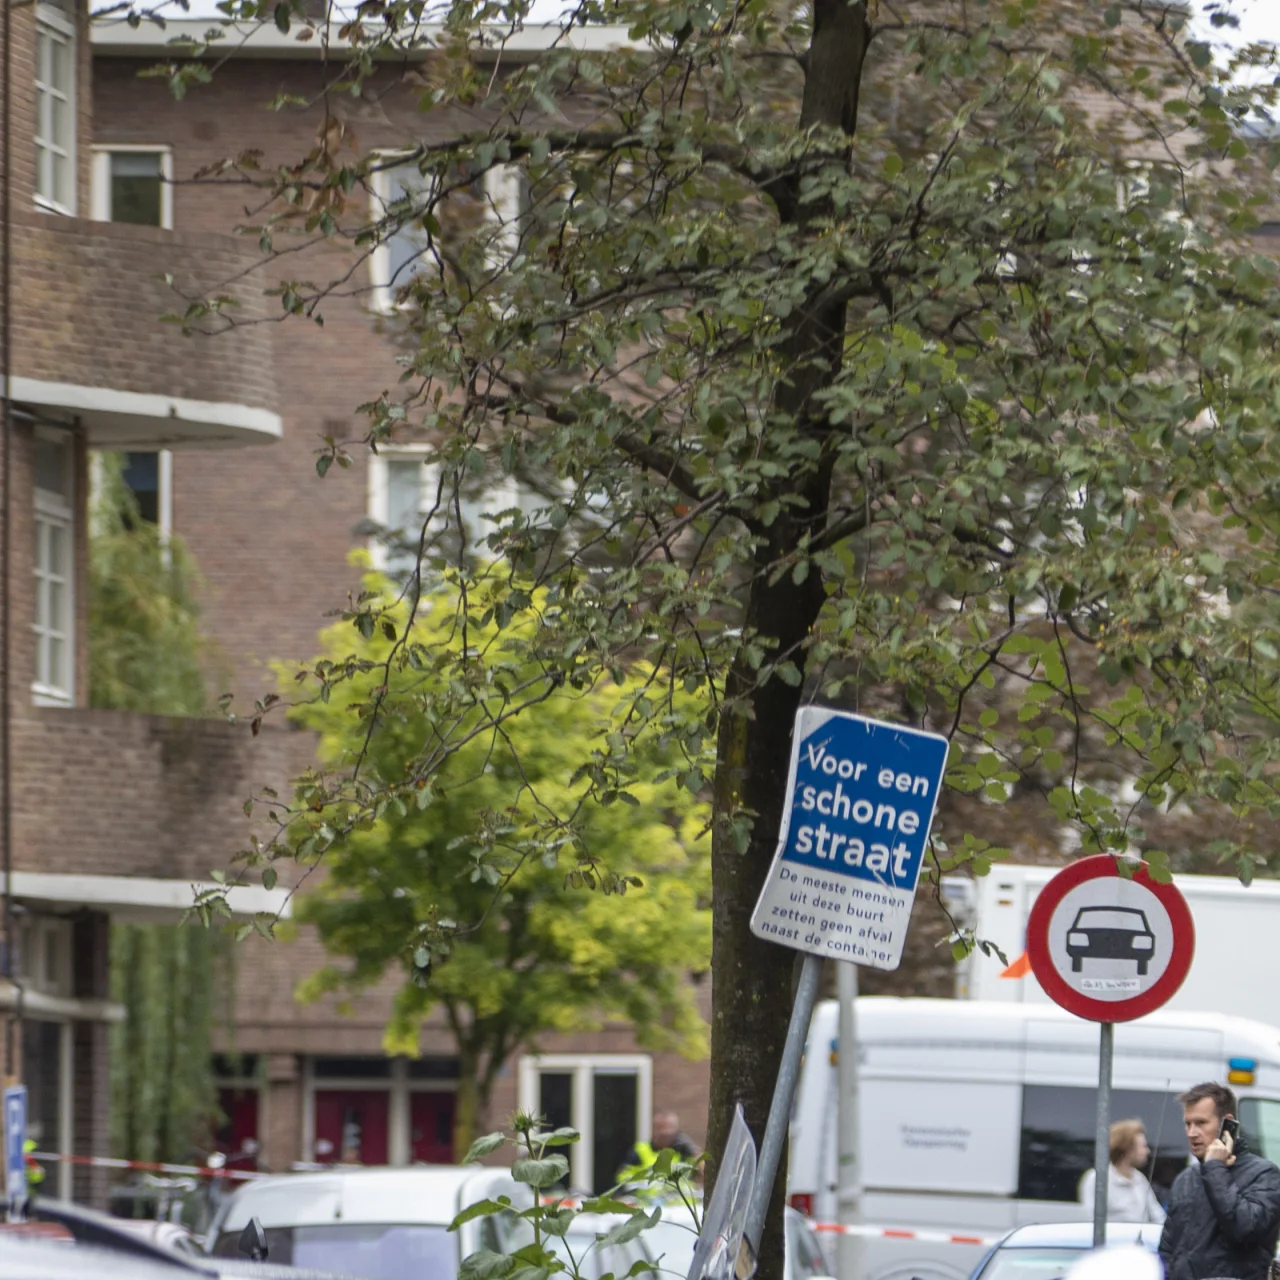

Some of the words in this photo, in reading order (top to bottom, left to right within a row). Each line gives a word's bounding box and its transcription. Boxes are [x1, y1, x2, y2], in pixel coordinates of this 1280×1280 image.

[807, 743, 867, 781] Voor
[878, 768, 929, 797] een
[801, 783, 920, 835] schone
[795, 823, 912, 877] straat
[779, 868, 798, 883] De
[802, 875, 847, 896] meeste
[852, 887, 906, 909] mensen
[789, 891, 807, 906] uit
[812, 894, 842, 913] deze
[847, 903, 885, 923] buurt
[761, 921, 800, 942] naast
[804, 931, 822, 946] de
[826, 939, 894, 964] contaner
[771, 904, 816, 926] zetten
[820, 918, 853, 936] geen
[858, 926, 894, 944] afval
